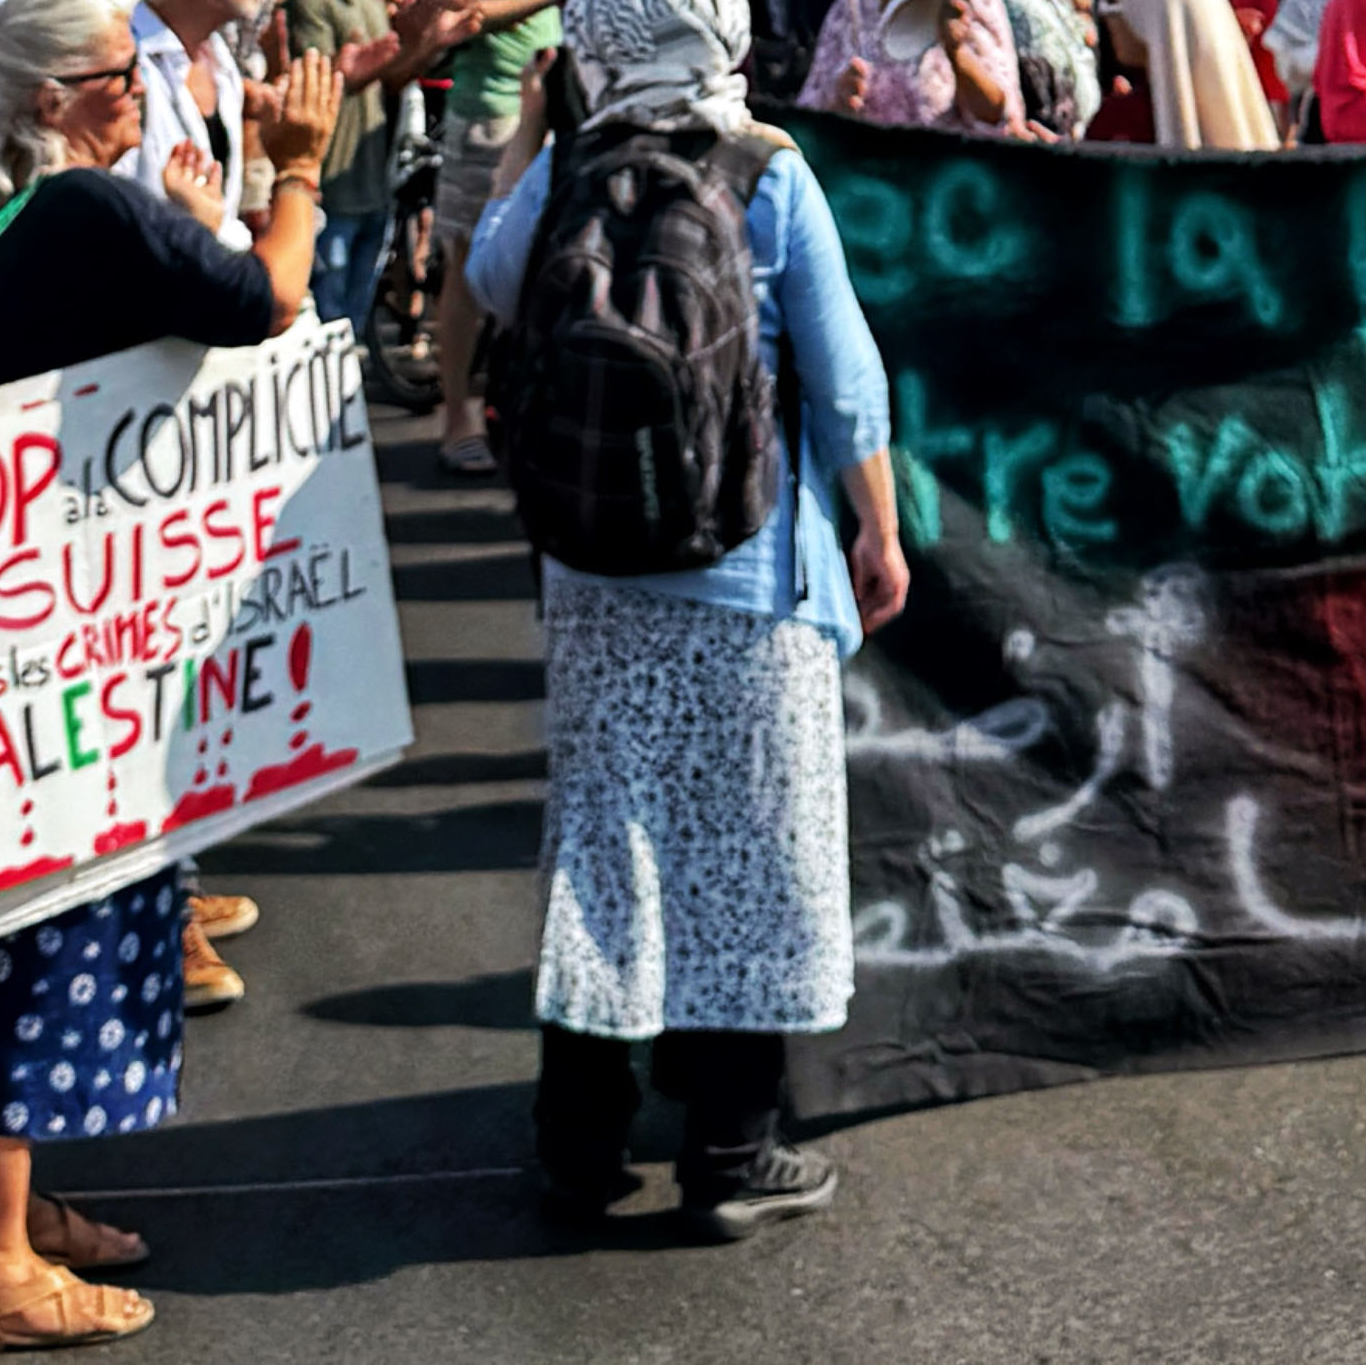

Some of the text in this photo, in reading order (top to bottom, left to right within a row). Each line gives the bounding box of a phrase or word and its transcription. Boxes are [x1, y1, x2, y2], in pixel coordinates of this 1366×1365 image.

[1109, 159, 1285, 329] la
[10, 645, 51, 688] les
[56, 597, 182, 679] CRIMES
